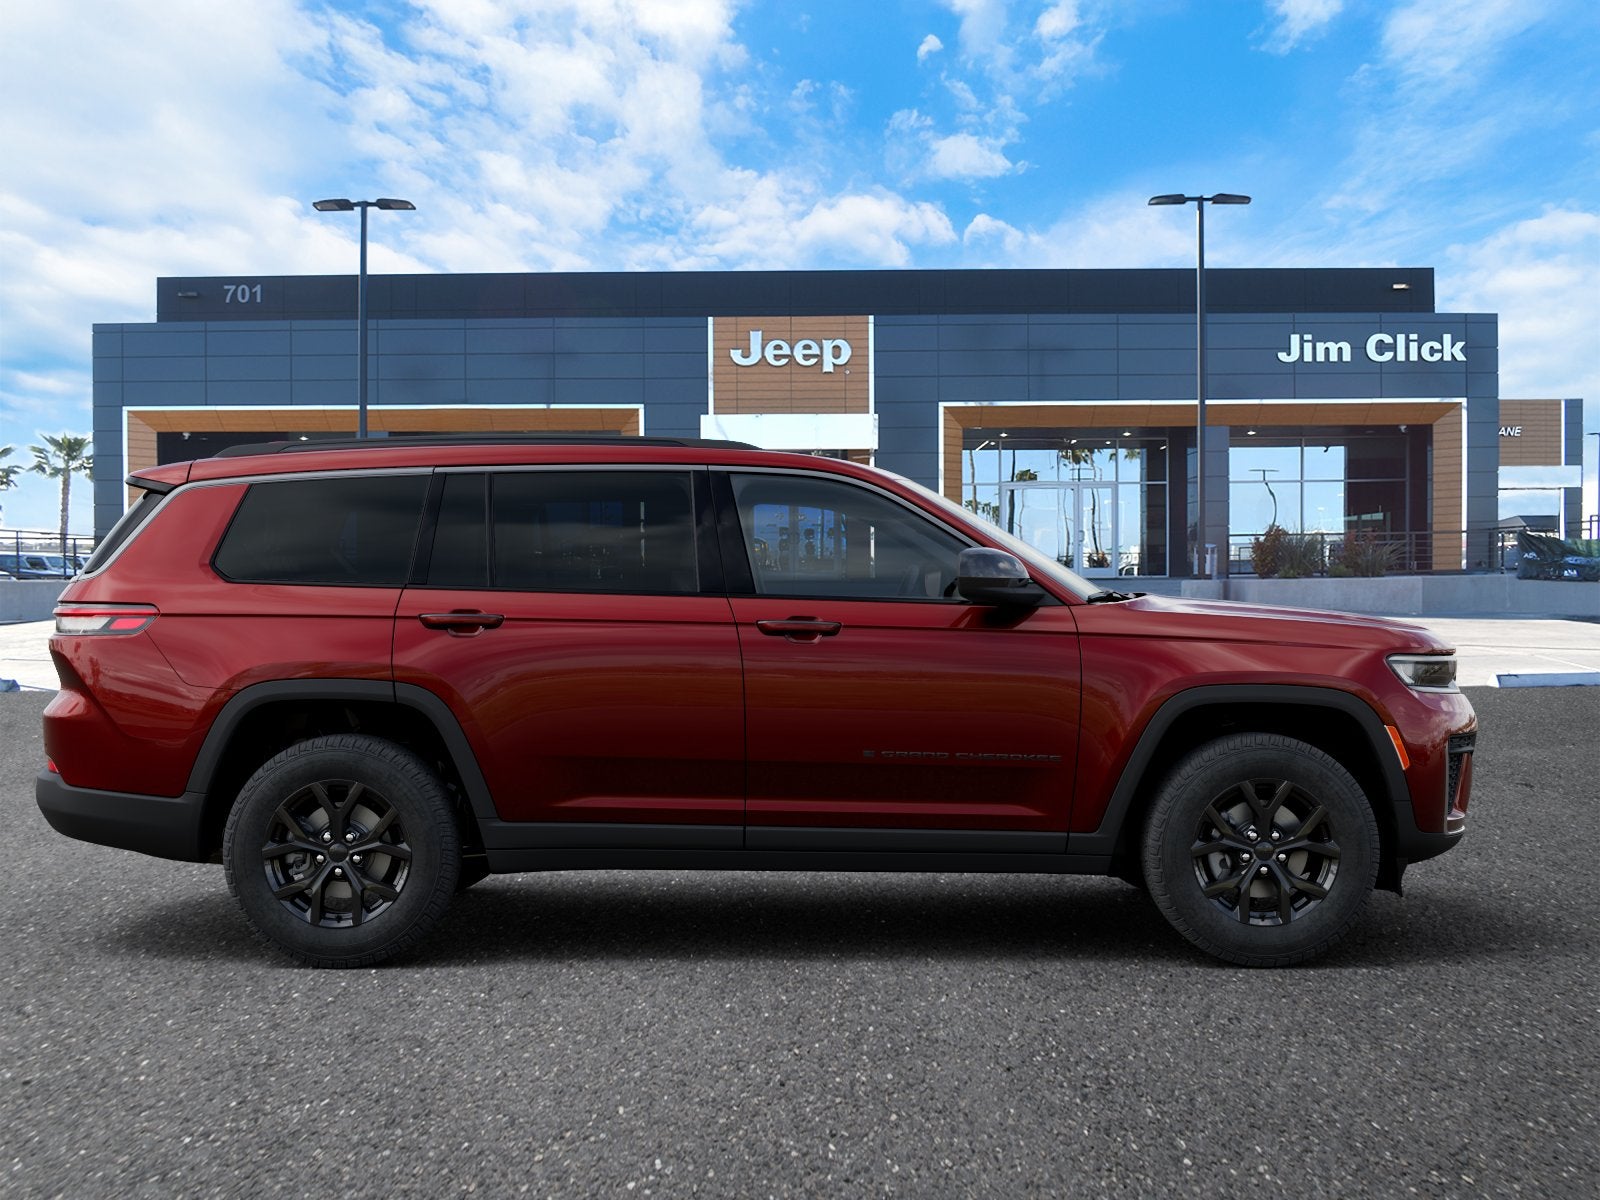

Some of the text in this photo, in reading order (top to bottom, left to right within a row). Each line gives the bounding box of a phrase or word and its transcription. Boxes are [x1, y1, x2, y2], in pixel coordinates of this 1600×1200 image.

[223, 284, 262, 304] 701
[729, 330, 852, 374] Jeep
[1277, 333, 1467, 363] Jim Click
